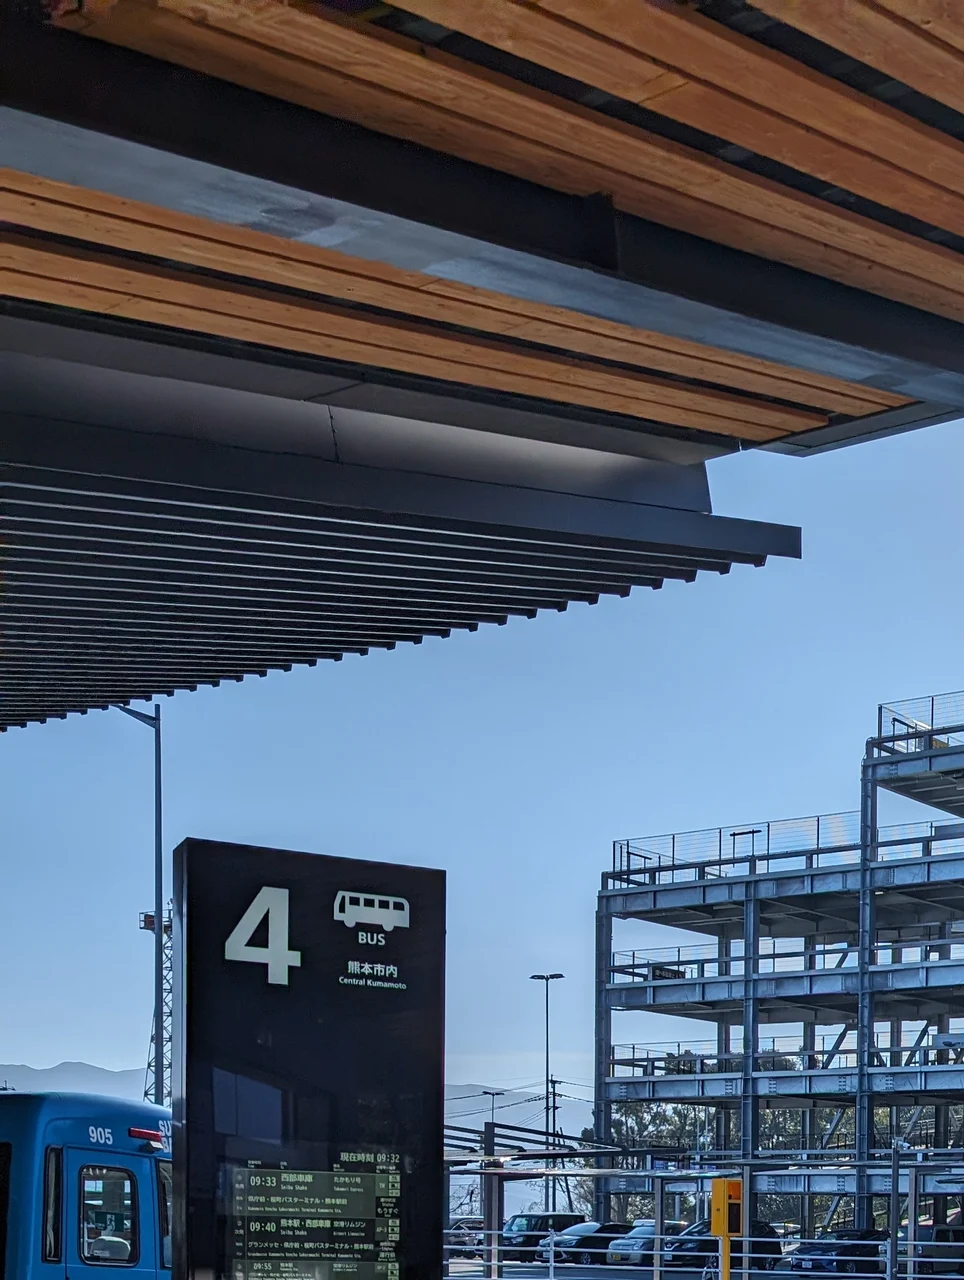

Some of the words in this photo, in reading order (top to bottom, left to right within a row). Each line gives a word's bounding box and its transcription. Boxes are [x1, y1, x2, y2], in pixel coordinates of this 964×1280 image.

[224, 886, 301, 986] 4
[358, 932, 386, 946] BUS
[347, 961, 398, 978] 熊本市内
[339, 977, 366, 986] Central
[366, 979, 407, 990] Kumamoto
[158, 1120, 172, 1136] SU
[88, 1126, 113, 1145] 905
[340, 1152, 374, 1163] 現在時刻
[376, 1154, 400, 1163] 09:32
[250, 1176, 277, 1187] 09:33
[250, 1222, 277, 1232] 09:40
